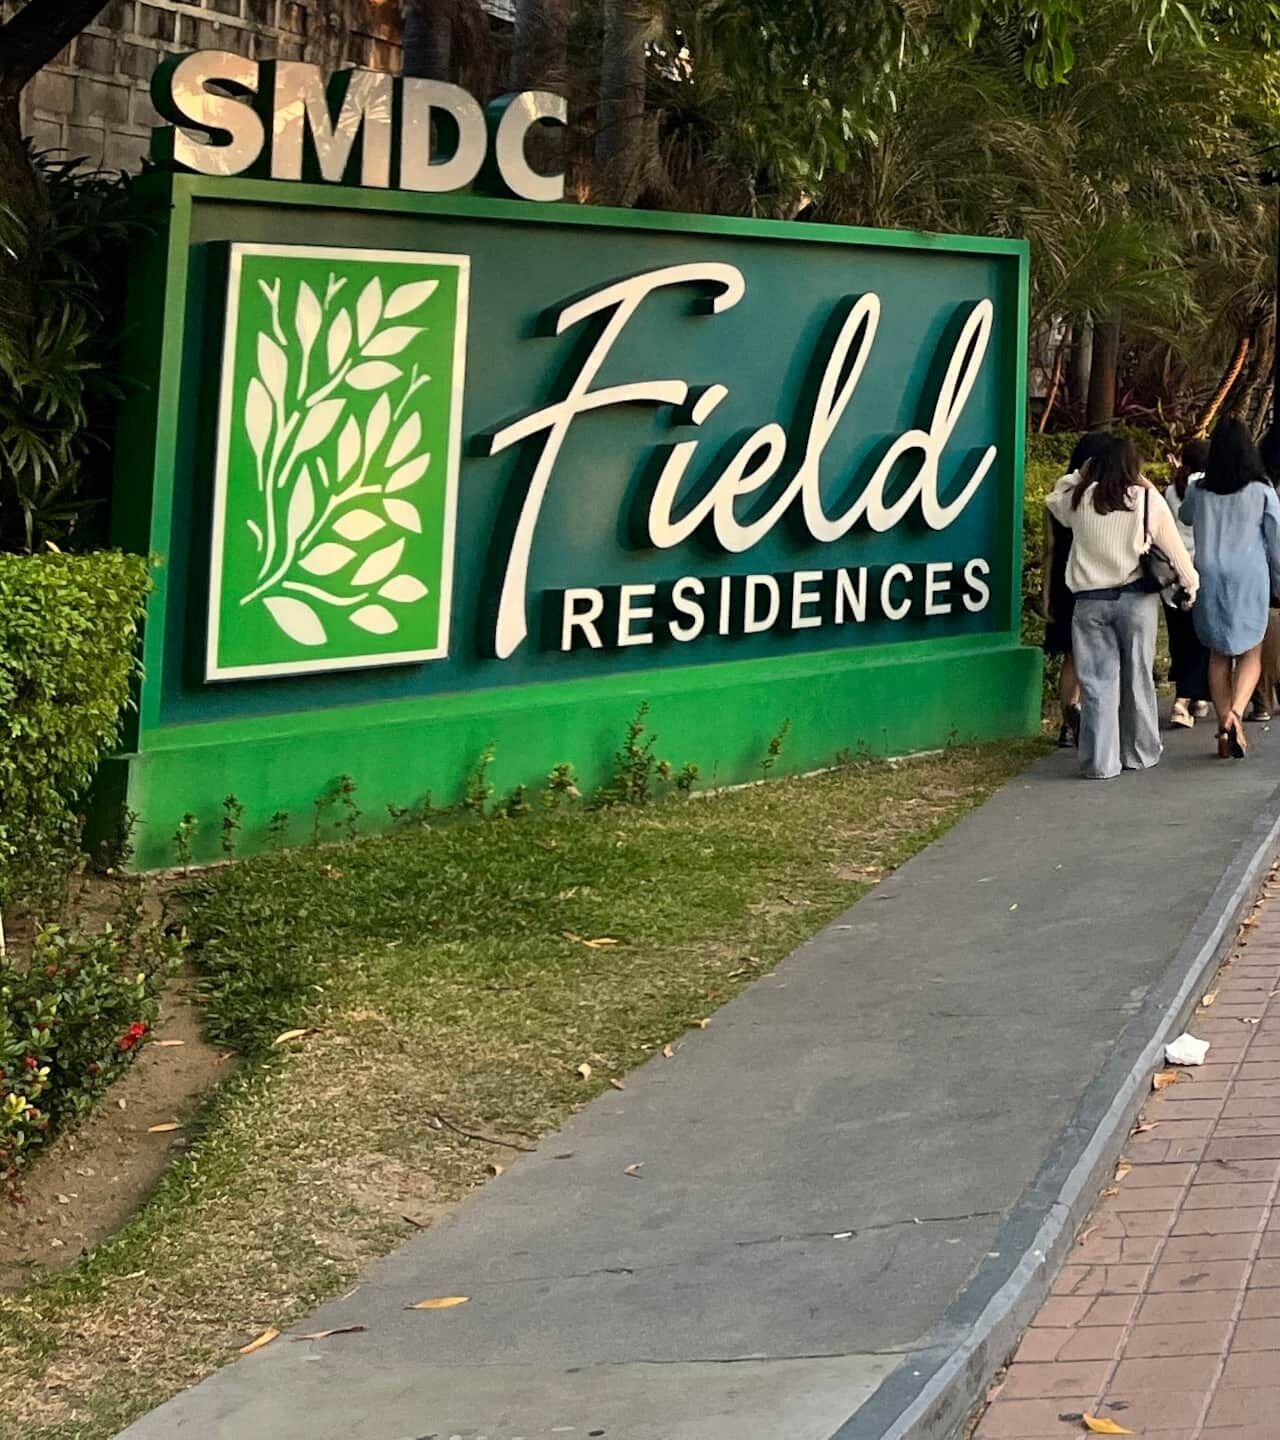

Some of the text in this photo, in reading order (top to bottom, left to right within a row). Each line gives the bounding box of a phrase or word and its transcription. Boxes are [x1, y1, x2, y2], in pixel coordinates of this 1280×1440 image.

[165, 49, 568, 202] SMDC
[489, 262, 998, 659] Field
[560, 558, 991, 651] RESIDENCES
